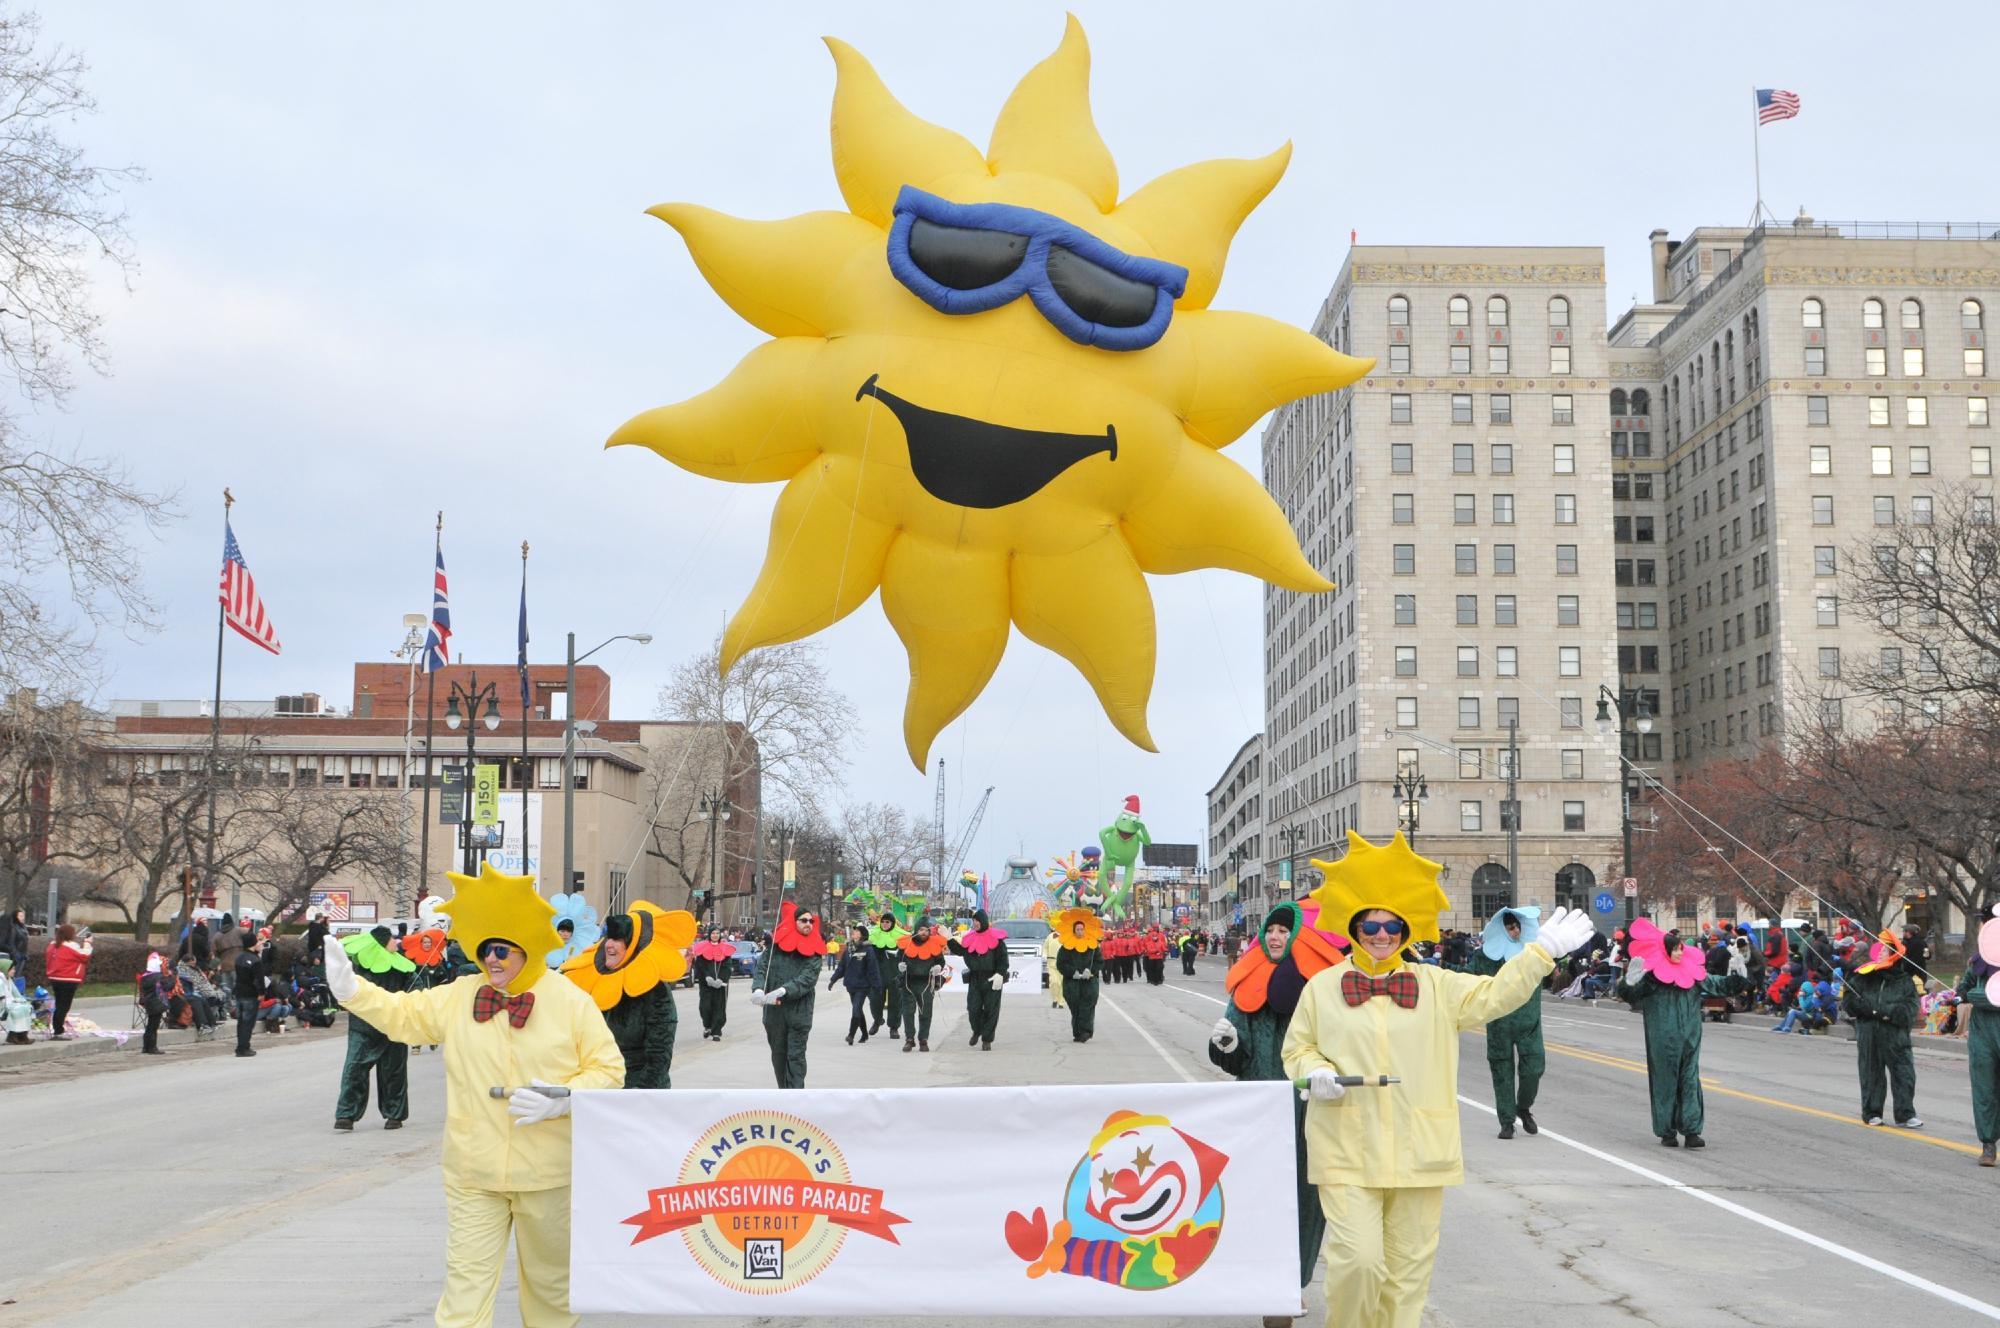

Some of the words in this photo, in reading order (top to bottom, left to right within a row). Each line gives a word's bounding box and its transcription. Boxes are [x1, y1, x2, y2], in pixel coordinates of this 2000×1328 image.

[478, 780, 490, 806] 150
[699, 1124, 832, 1176] AMERICA'S
[656, 1184, 795, 1215] THANKSGIVING
[801, 1185, 873, 1215] PARADE
[732, 1216, 799, 1231] DETROIT
[700, 1228, 730, 1264] PRESENTED
[729, 1260, 740, 1270] BY
[753, 1243, 775, 1255] Art
[753, 1255, 778, 1266] Van
